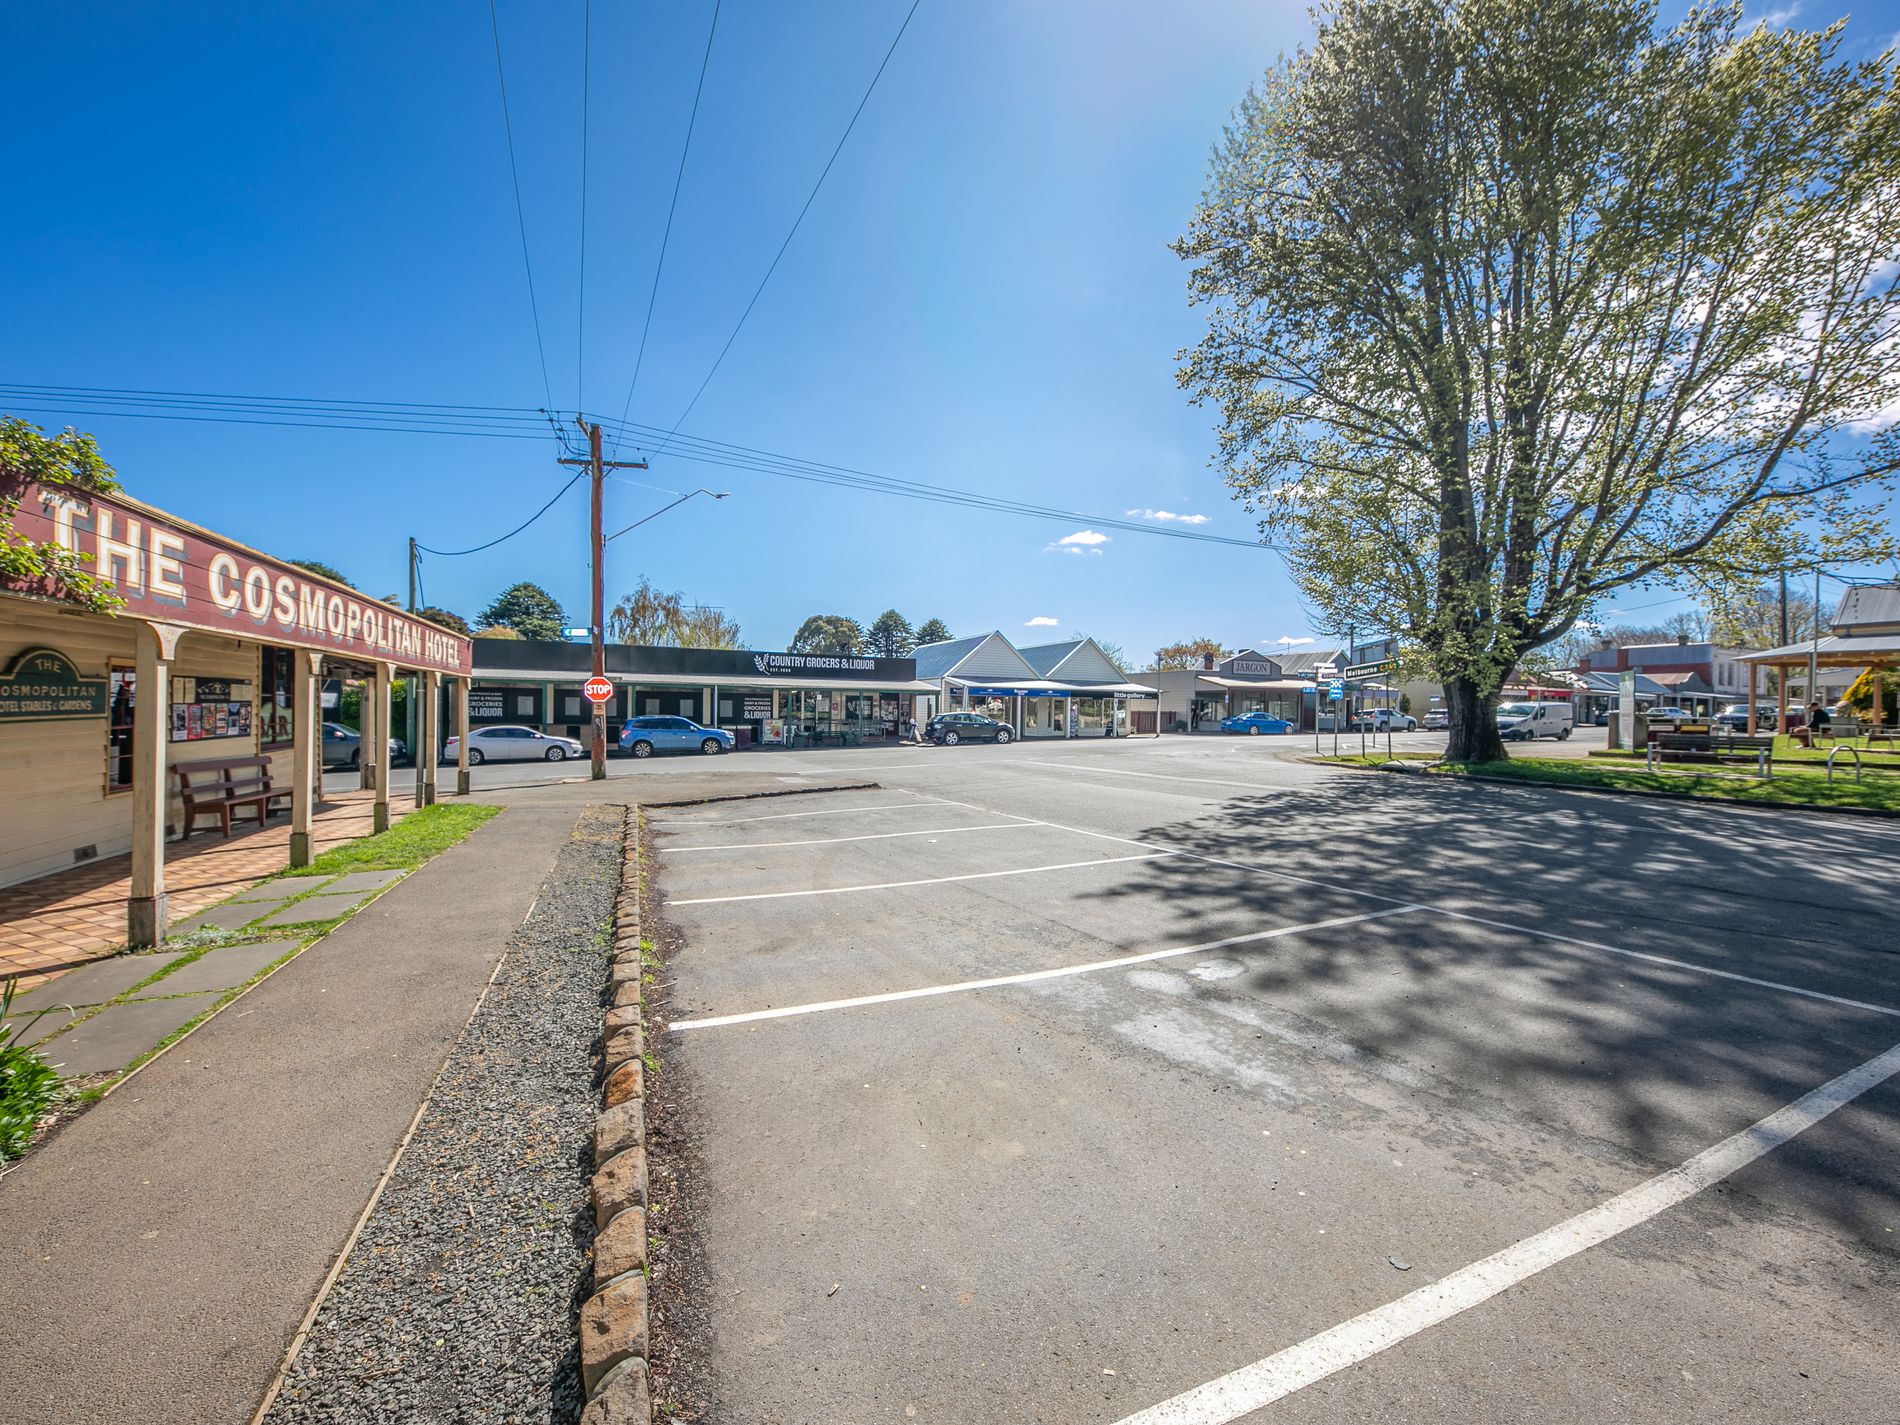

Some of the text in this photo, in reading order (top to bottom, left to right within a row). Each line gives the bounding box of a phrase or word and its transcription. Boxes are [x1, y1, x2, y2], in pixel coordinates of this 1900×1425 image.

[38, 490, 461, 666] THE COSMOPOLITAN HOTEL
[35, 659, 62, 673] THE
[770, 655, 875, 670] COUNTRY GROCERS & LIQUOR
[1236, 662, 1268, 673] JARGON
[1347, 666, 1378, 677] Melbourne
[0, 685, 96, 697] OSMOPOLITAN
[586, 684, 611, 695] STOP
[0, 701, 19, 712] OTEL
[21, 701, 52, 712] STABLES
